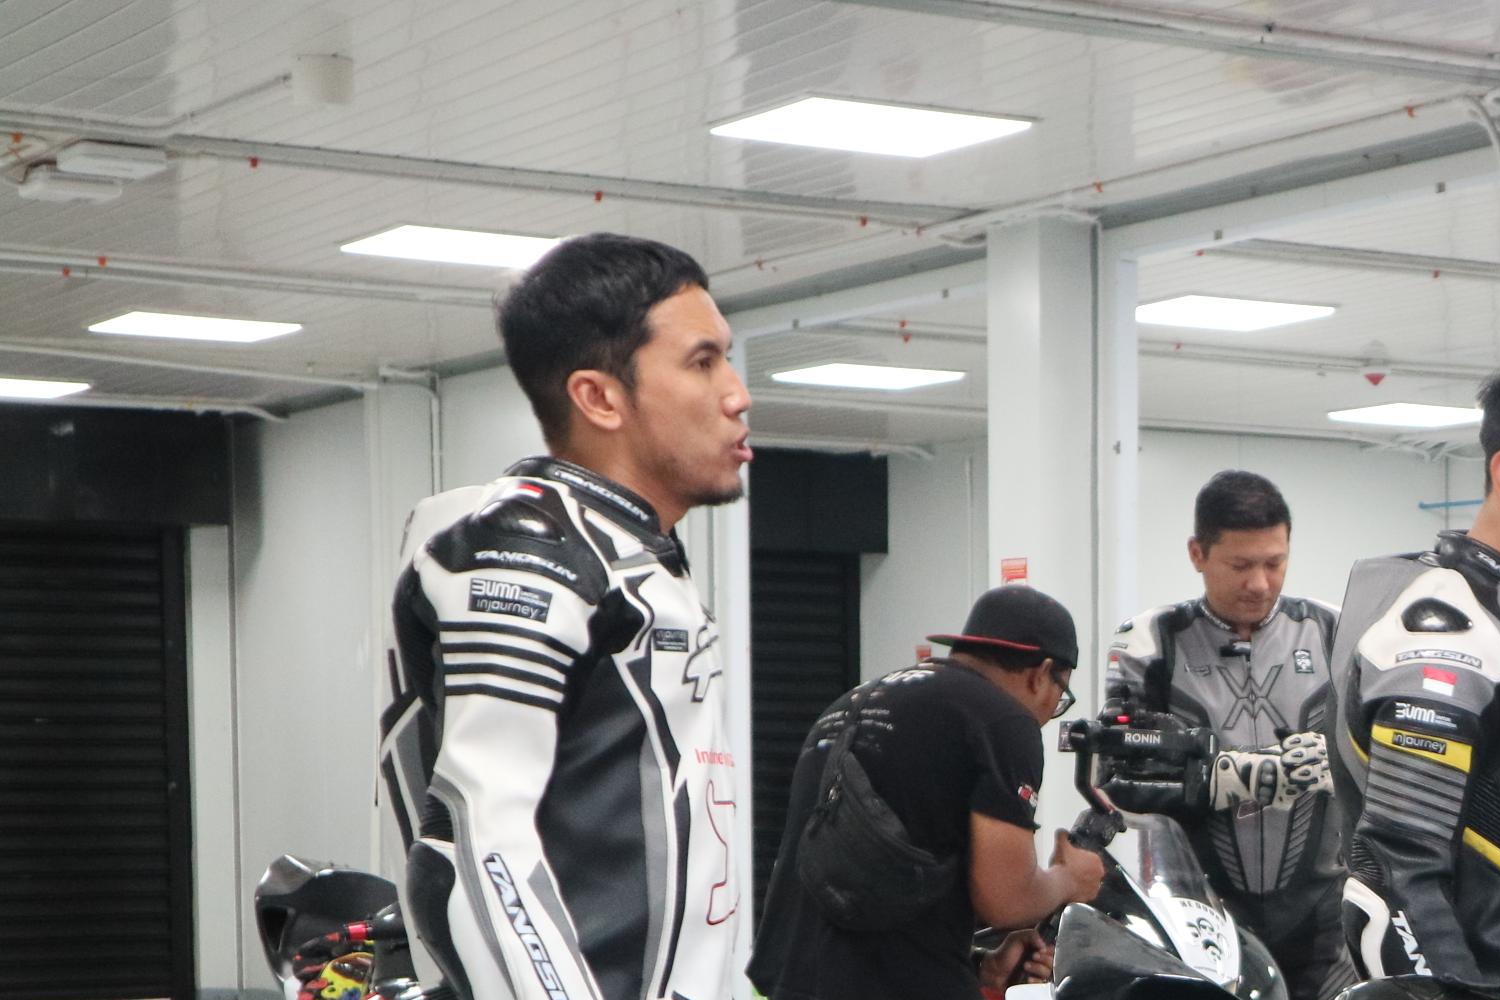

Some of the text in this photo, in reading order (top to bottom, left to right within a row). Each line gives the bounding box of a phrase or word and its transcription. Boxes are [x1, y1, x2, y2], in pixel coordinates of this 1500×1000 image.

[475, 550, 578, 582] TANGSUN
[476, 598, 540, 620] injourney
[1124, 732, 1161, 744] RONIN
[1393, 731, 1446, 753] injourney
